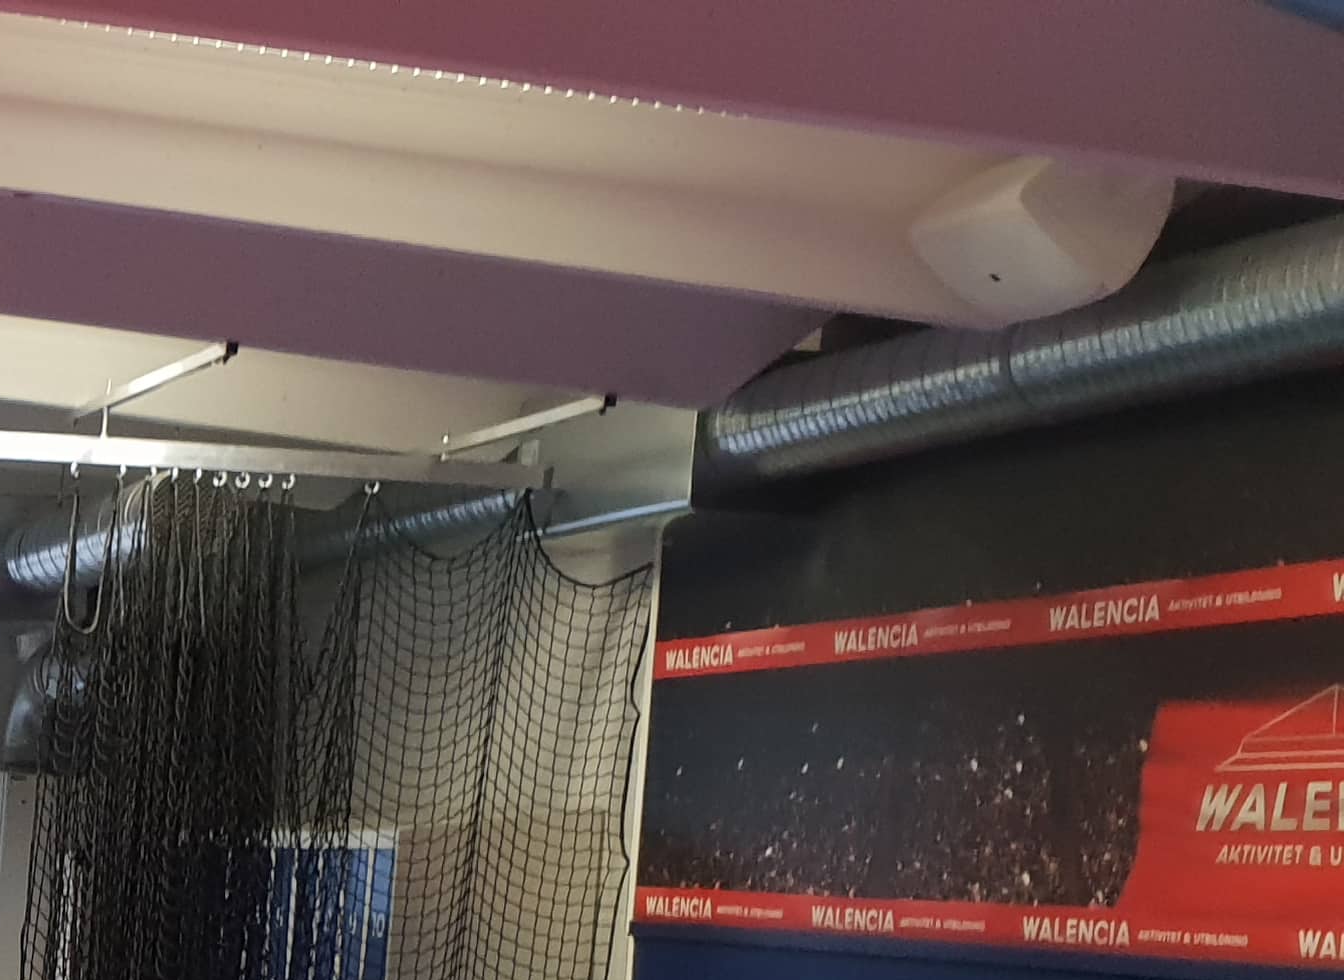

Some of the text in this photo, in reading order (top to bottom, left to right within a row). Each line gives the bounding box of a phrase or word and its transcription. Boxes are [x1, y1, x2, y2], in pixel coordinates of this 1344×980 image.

[1049, 595, 1160, 632] WALENCIA
[834, 623, 918, 655] WALENCIA
[666, 643, 733, 671] WALENCIA
[1215, 844, 1303, 865] AKTIVITET
[1309, 845, 1321, 866] &
[646, 895, 712, 919] WALENCIA
[812, 904, 894, 932] WALENCIA
[371, 912, 385, 938] 10
[1023, 916, 1130, 946] WALENCIA
[1298, 929, 1344, 960] WA
